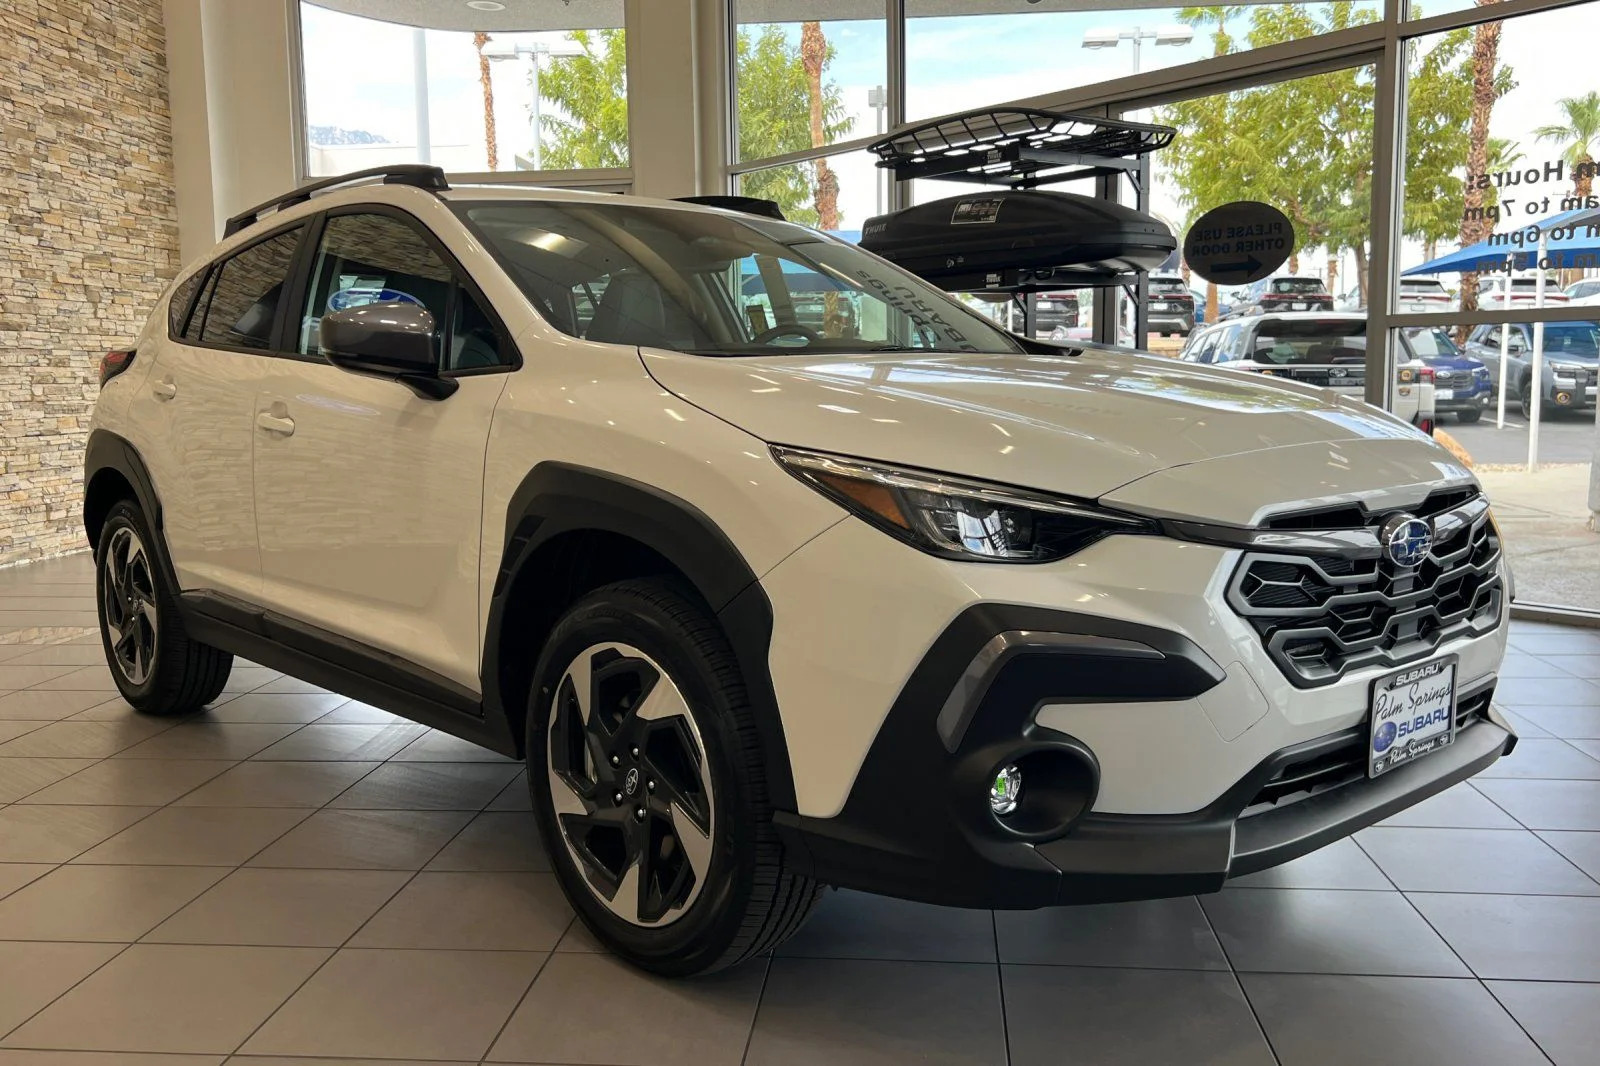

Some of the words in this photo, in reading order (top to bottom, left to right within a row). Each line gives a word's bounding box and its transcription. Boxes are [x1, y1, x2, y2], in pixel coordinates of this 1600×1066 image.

[1395, 663, 1439, 687] SUBARU
[1375, 693, 1404, 720] Palm
[1408, 681, 1451, 715] Springs
[1397, 705, 1450, 738] SUBARU
[1389, 749, 1407, 765] Palm
[1408, 740, 1435, 758] Springs
